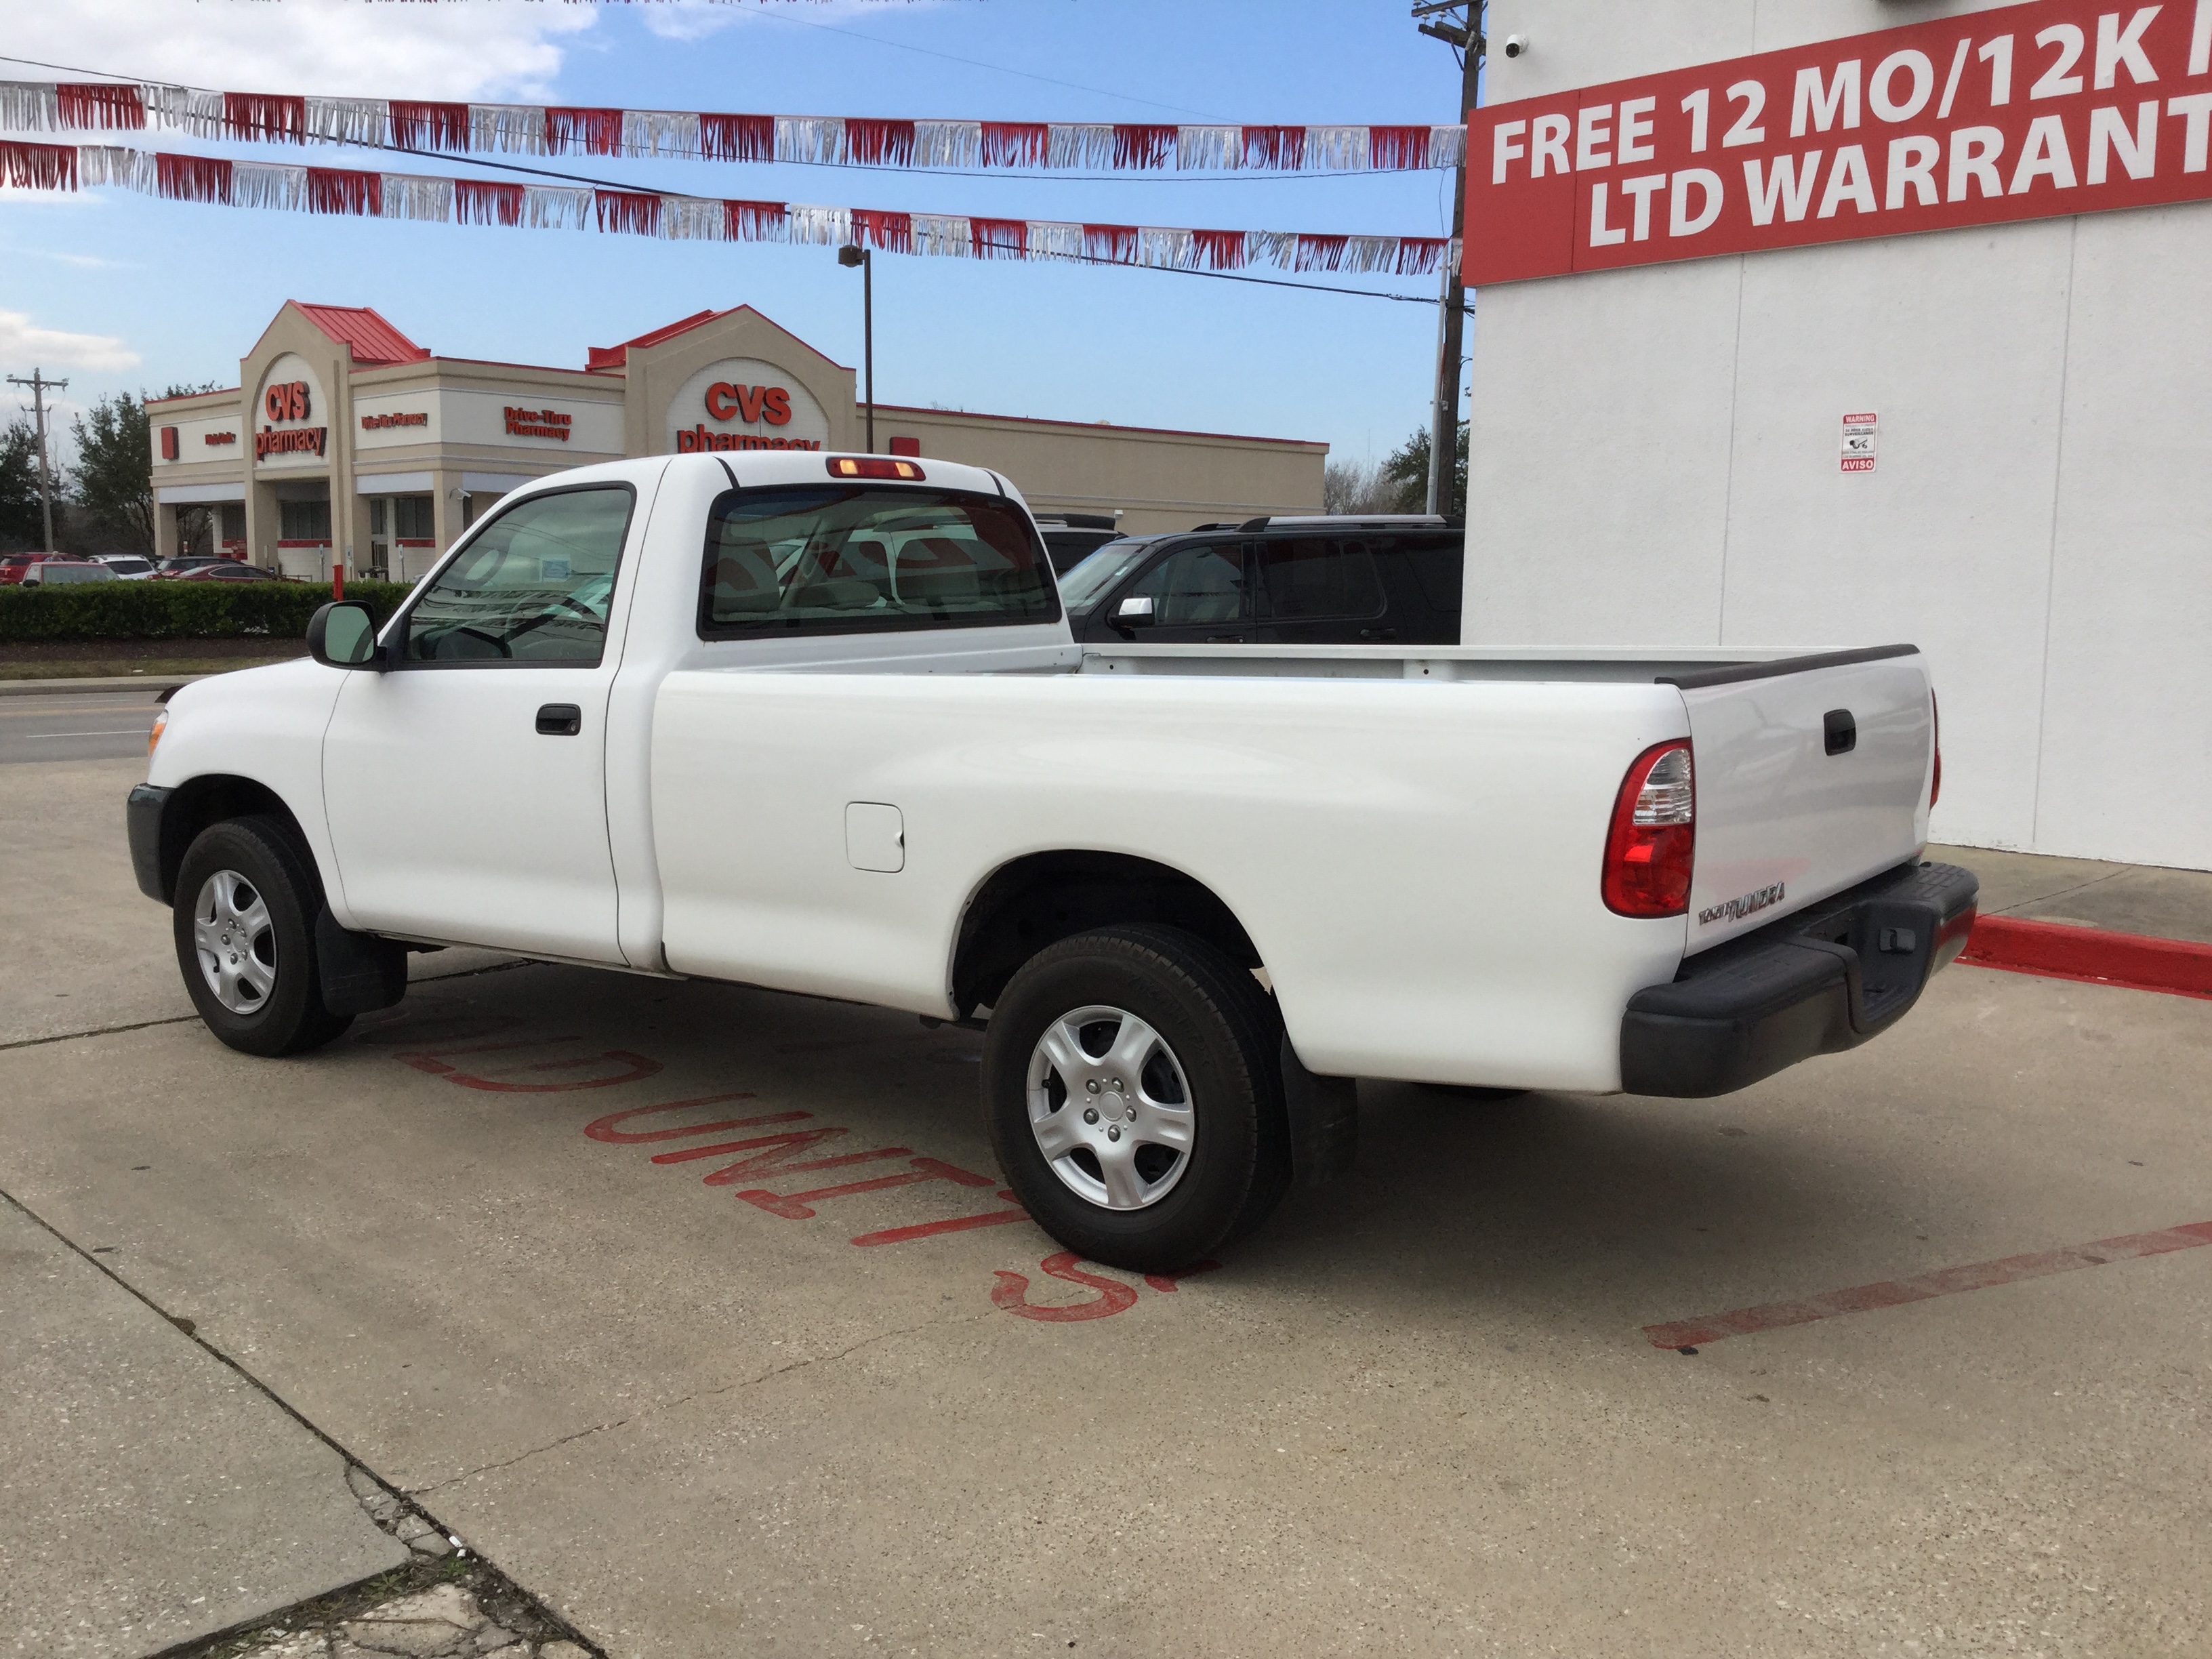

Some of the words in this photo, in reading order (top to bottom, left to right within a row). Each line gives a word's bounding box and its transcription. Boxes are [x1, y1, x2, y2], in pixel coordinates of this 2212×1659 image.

[1492, 96, 1656, 185] FREE
[1681, 80, 1765, 154] 12
[1790, 5, 2164, 138] MO/12K
[1589, 168, 1725, 247] LTD
[265, 380, 311, 422] CVS
[504, 406, 571, 425] Drive-Thru
[705, 382, 792, 426] CVS
[1845, 414, 1875, 423] WARNING
[255, 425, 327, 462] pharmacy
[506, 420, 571, 442] Pharmacy
[1842, 460, 1874, 470] AVISO
